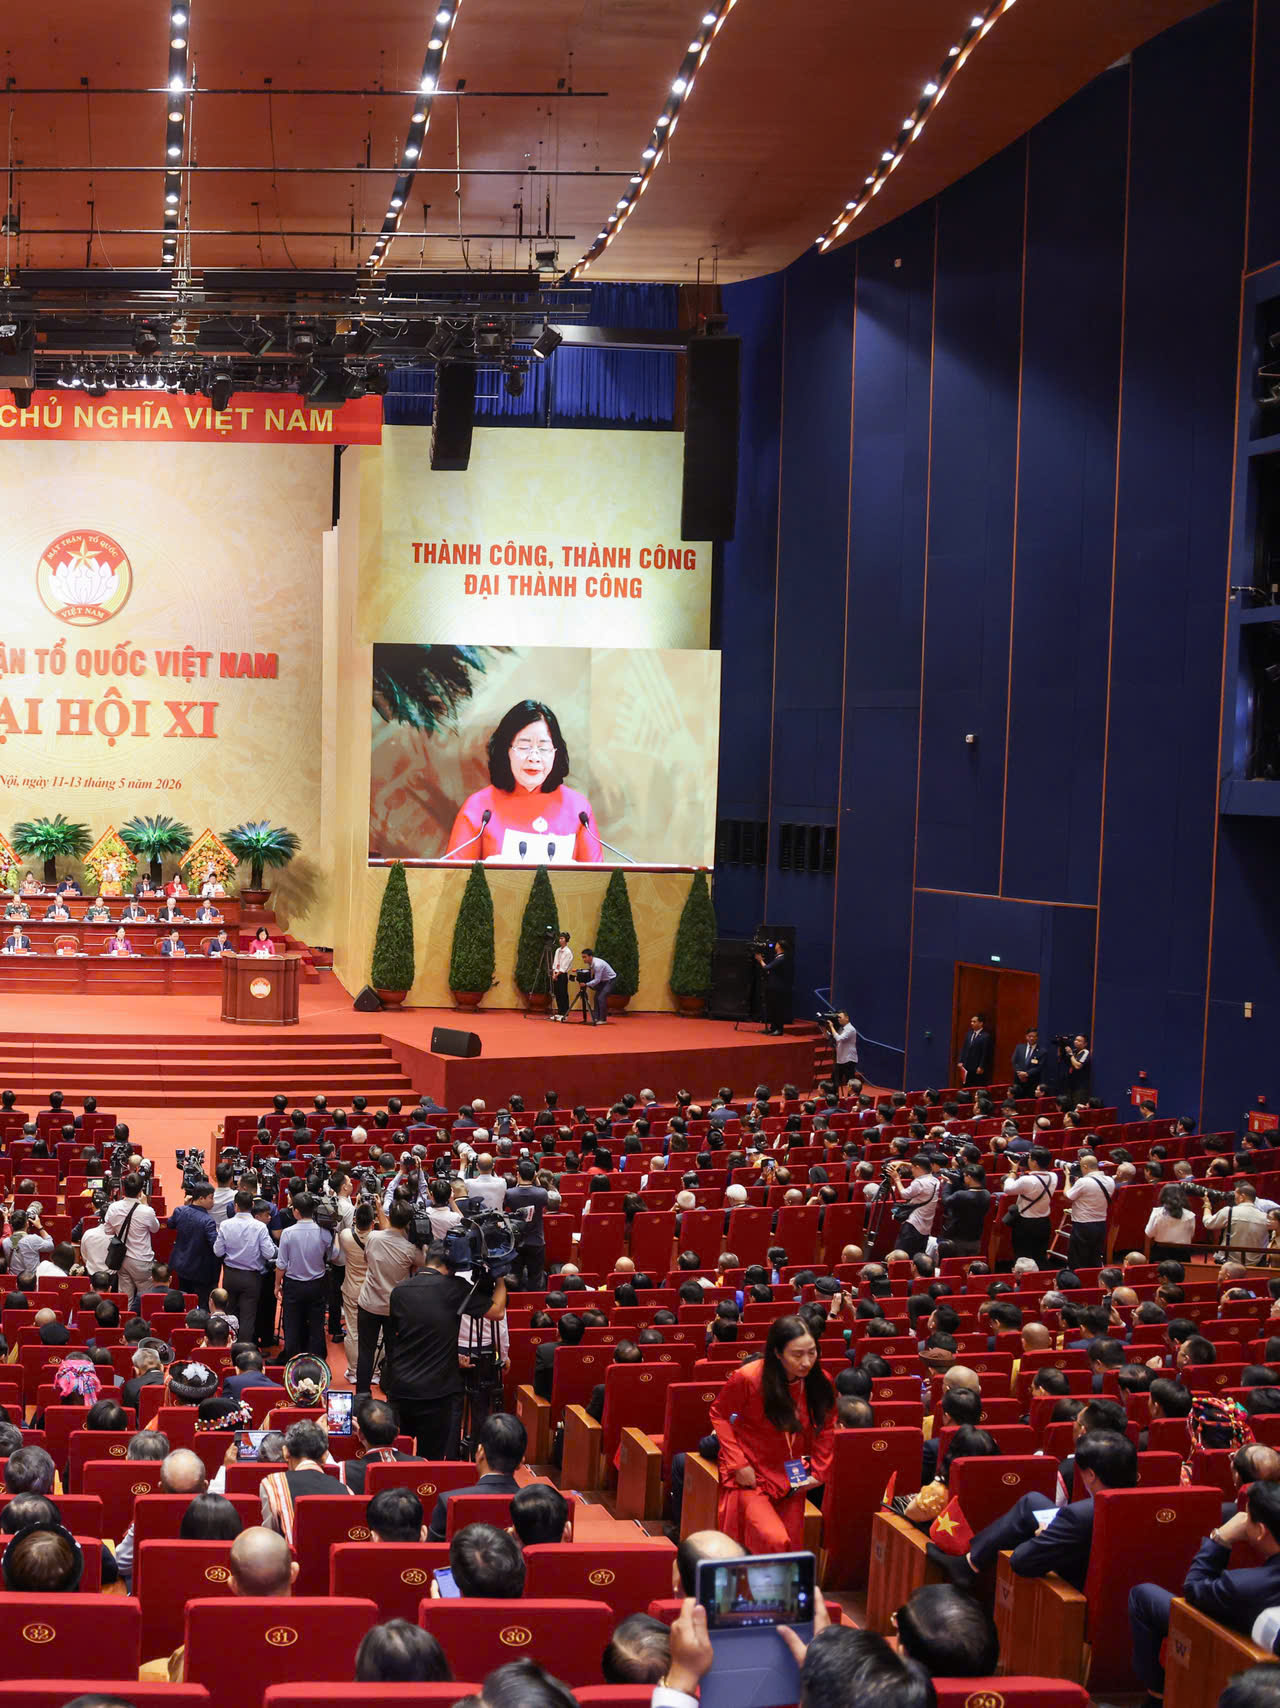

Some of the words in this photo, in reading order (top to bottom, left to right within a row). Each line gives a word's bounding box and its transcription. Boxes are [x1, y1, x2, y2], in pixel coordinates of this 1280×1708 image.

[74, 401, 174, 429] NGHĨA
[265, 408, 333, 432] NAM
[412, 539, 481, 565] THÀNH
[490, 540, 553, 569] CÔNG,
[561, 542, 631, 569] THÀNH
[639, 543, 697, 570] CÔNG
[464, 573, 500, 600] ĐẠI
[508, 571, 577, 598] THÀNH
[585, 572, 643, 599] CÔNG
[34, 638, 68, 676] TỔ
[75, 640, 146, 678] QUỐC
[155, 645, 212, 683] VIỆT
[219, 651, 279, 679] NAM
[56, 686, 151, 747] HỘI
[163, 701, 219, 739] XI
[22, 775, 50, 791] ngày
[52, 776, 82, 788] 11-13
[84, 777, 116, 791] tháng
[119, 778, 126, 789] 5
[128, 778, 153, 790] năm
[155, 779, 182, 790] 2026
